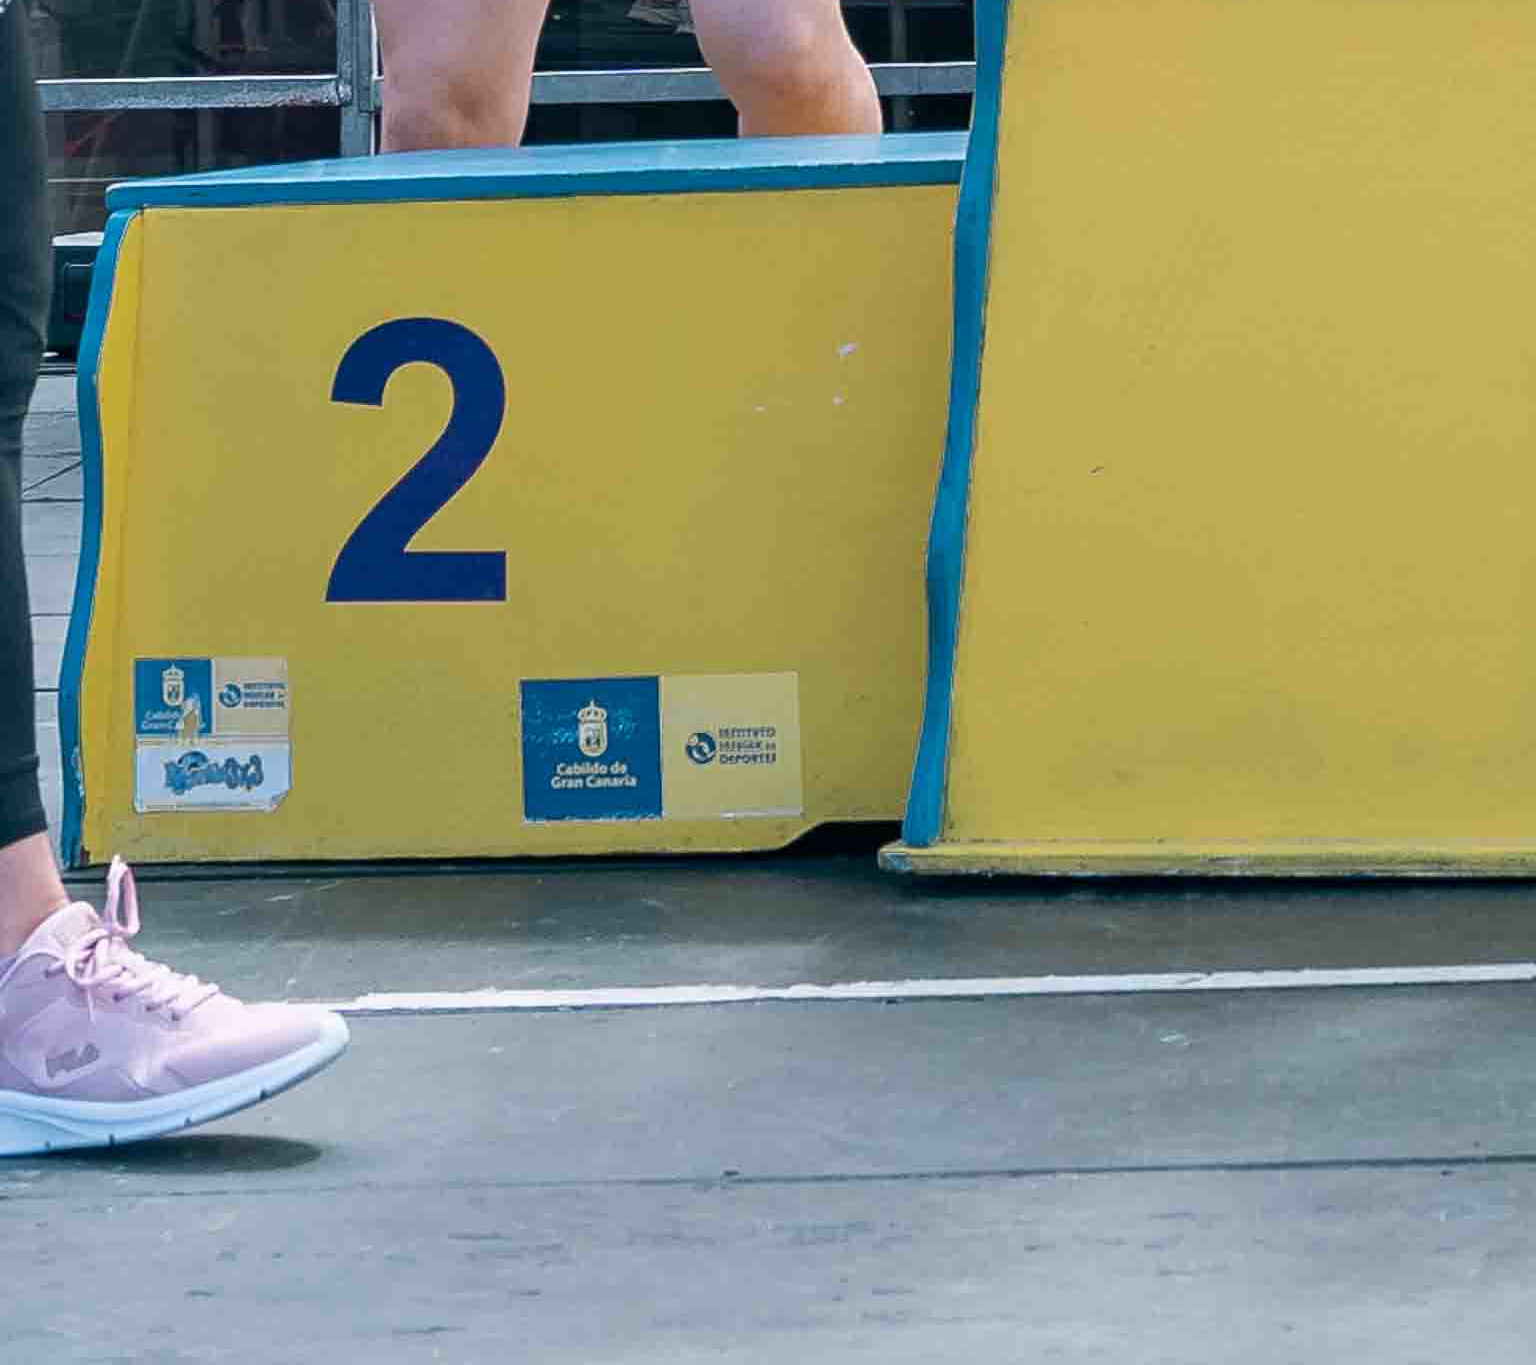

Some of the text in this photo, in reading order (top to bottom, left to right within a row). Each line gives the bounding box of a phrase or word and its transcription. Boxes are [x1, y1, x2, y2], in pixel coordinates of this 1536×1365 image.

[324, 316, 508, 604] 2
[555, 760, 628, 775] Cabildo de
[550, 774, 637, 789] Gran Canaria
